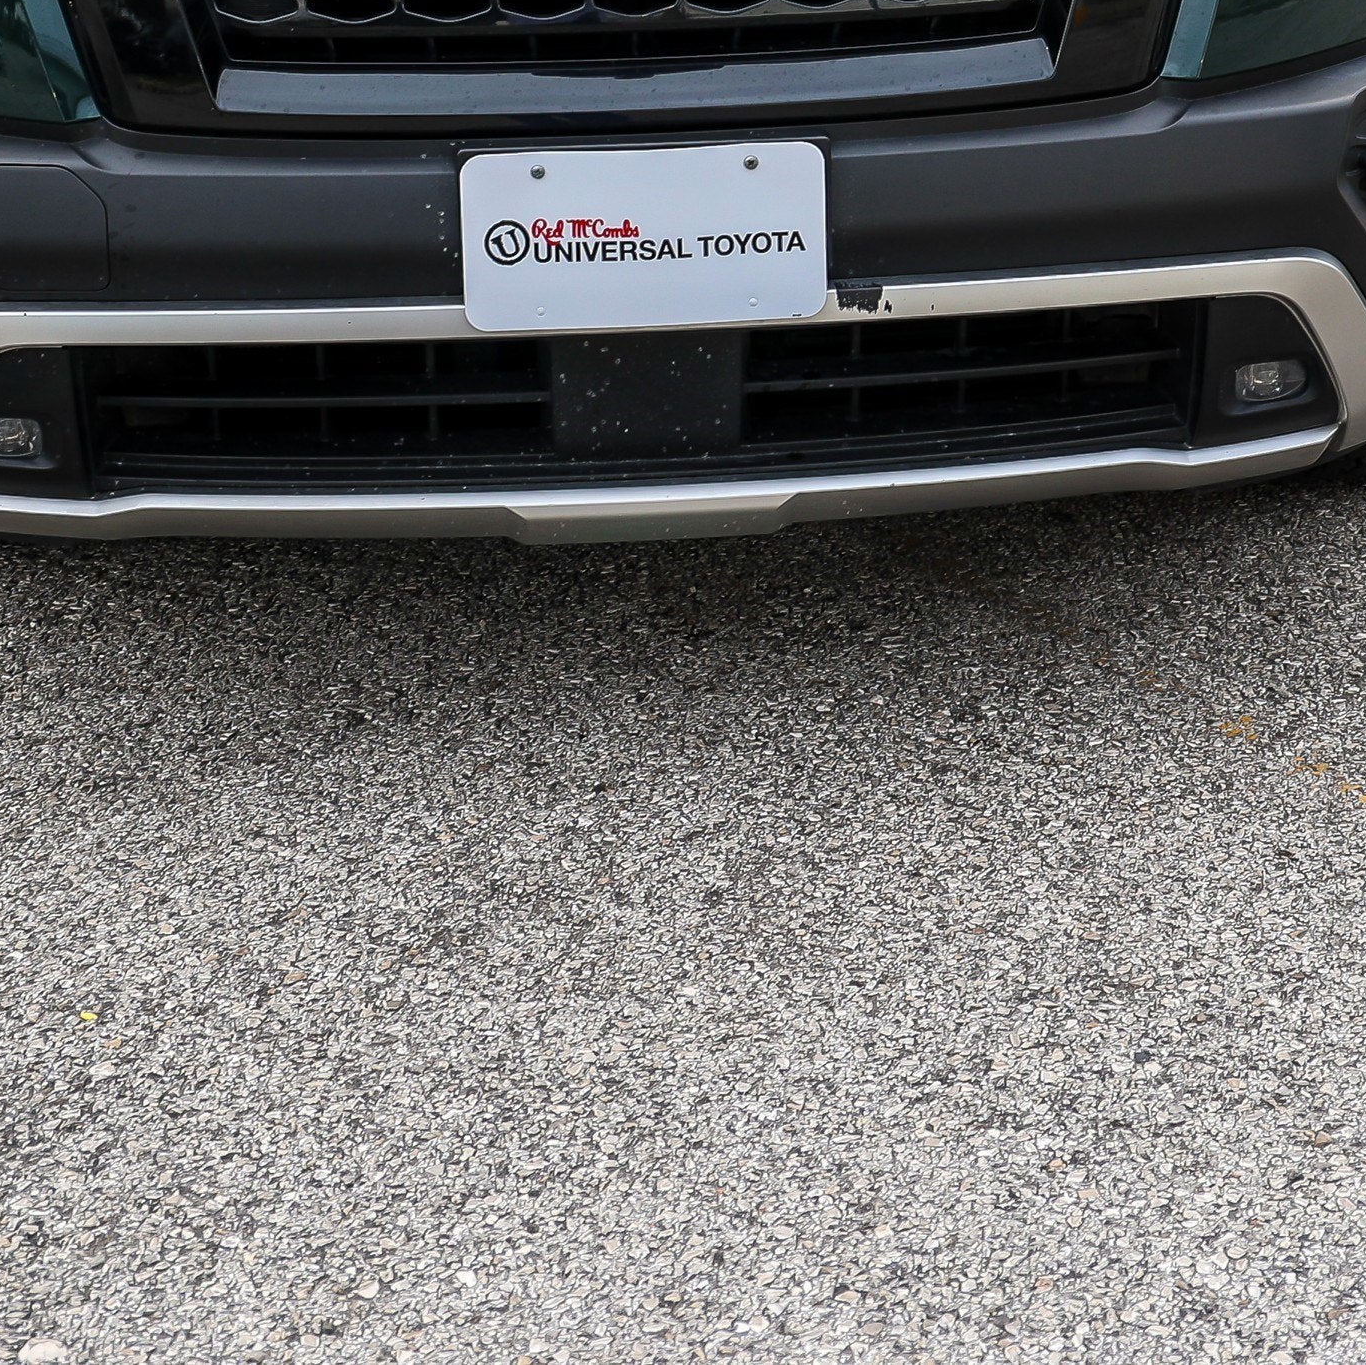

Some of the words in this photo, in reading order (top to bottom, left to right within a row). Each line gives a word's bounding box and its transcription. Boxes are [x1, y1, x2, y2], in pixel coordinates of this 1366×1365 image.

[531, 218, 565, 246] Red
[566, 219, 640, 239] McCombs
[534, 237, 693, 263] UNIVERSAL
[697, 231, 806, 257] TOYOTA
